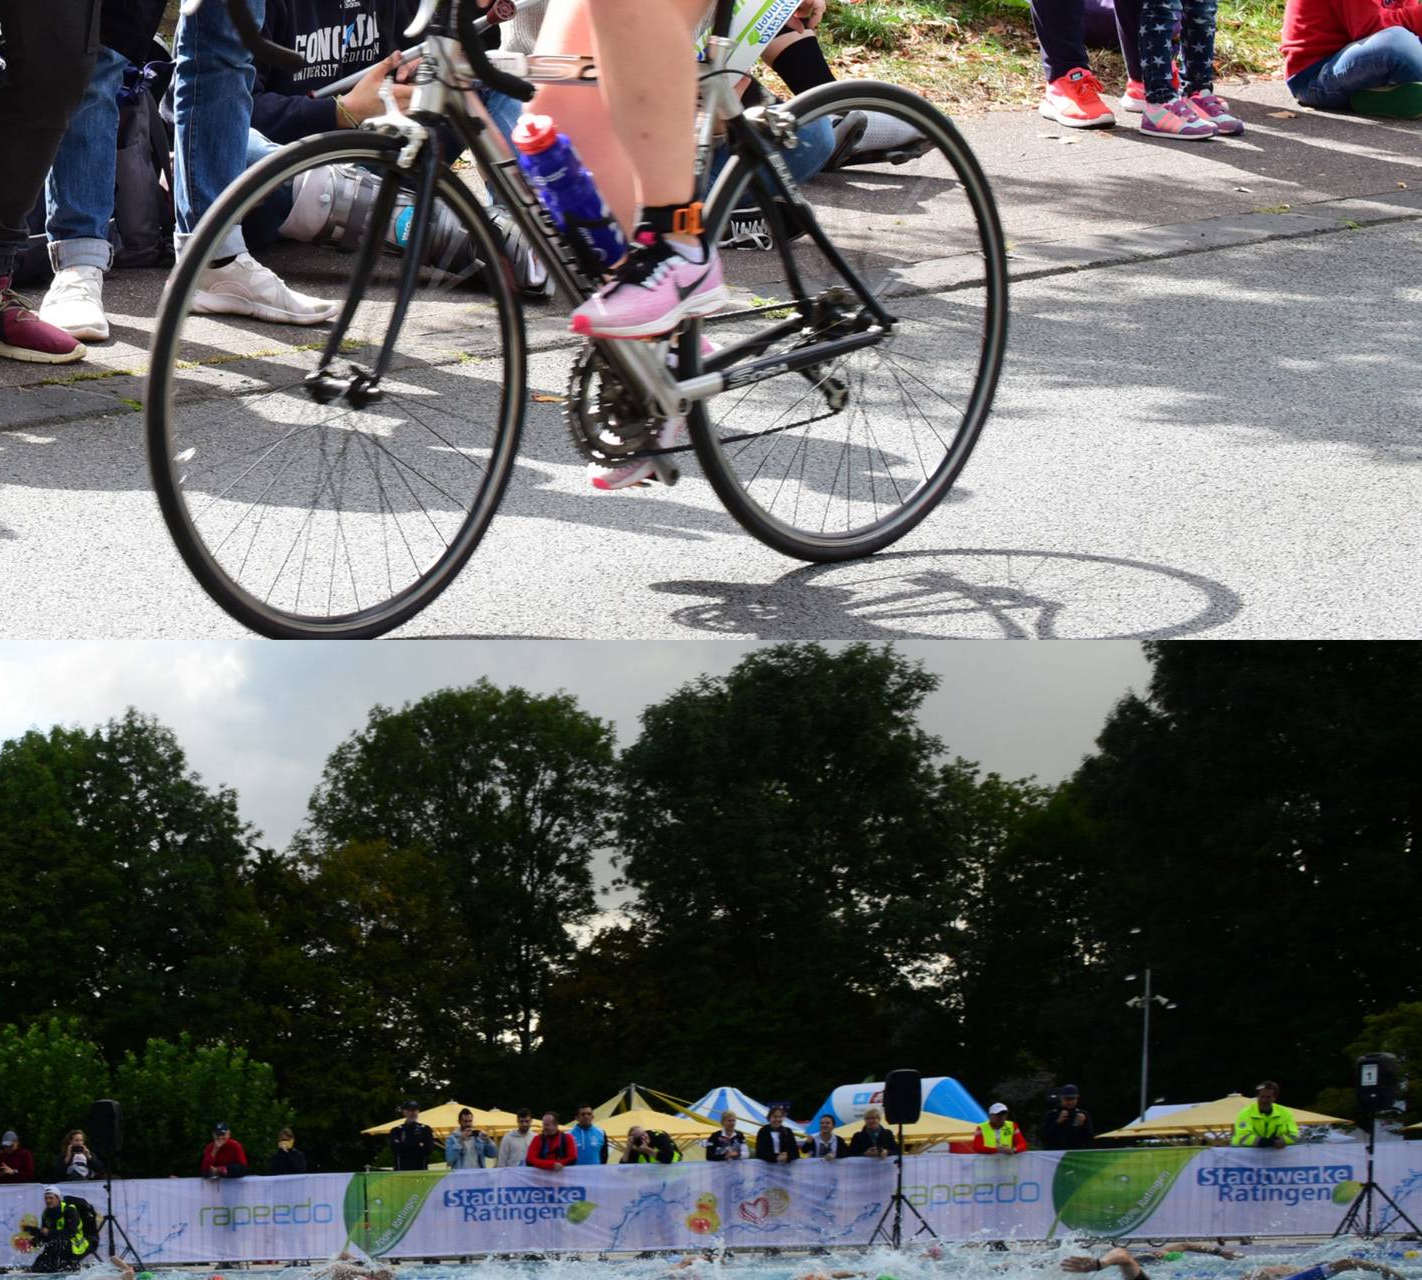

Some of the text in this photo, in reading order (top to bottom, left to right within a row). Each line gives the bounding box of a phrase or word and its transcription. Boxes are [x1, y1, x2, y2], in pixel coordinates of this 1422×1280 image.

[1201, 1166, 1349, 1186] Stadtwerke
[448, 1188, 582, 1207] Stadtwerke
[1218, 1184, 1331, 1207] Ratingen
[200, 1197, 332, 1232] rapeedo
[463, 1204, 566, 1225] Ratingen
